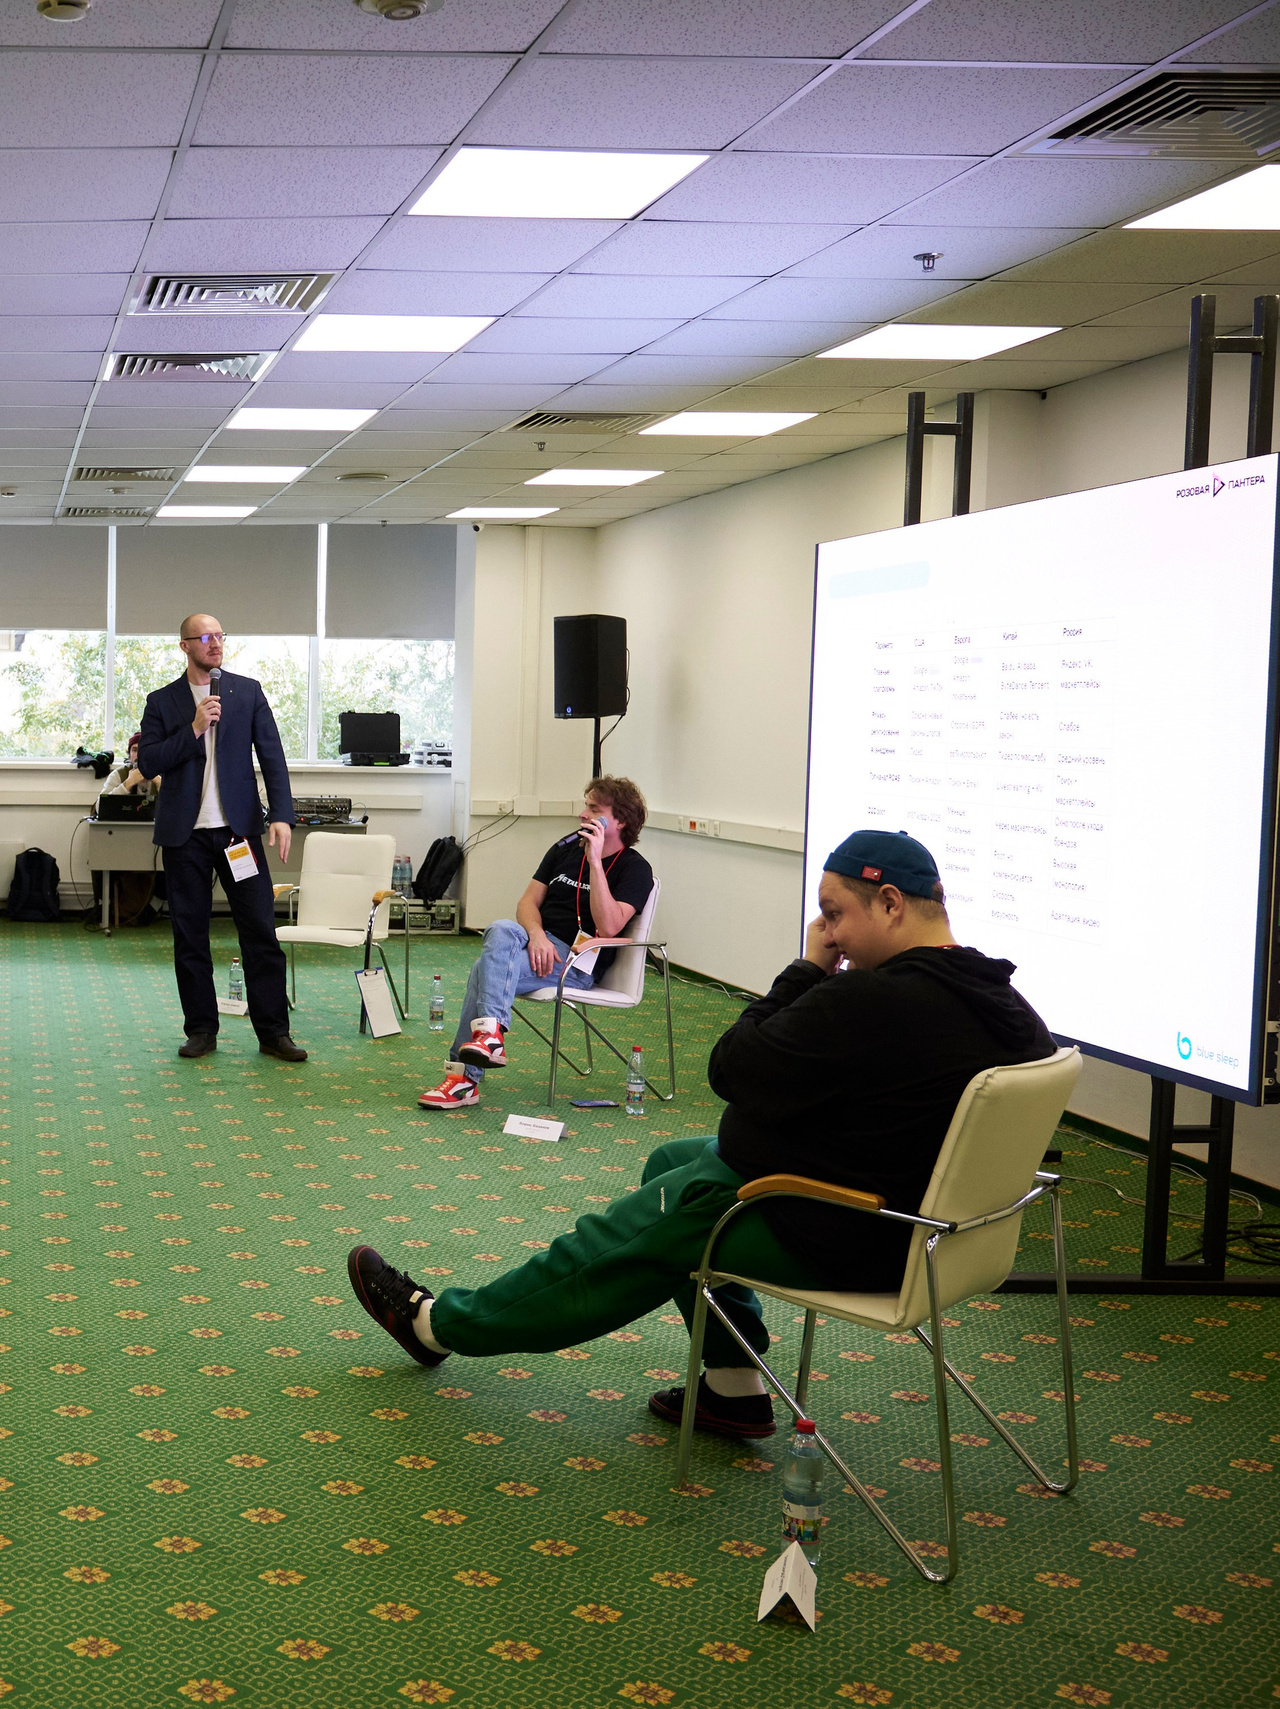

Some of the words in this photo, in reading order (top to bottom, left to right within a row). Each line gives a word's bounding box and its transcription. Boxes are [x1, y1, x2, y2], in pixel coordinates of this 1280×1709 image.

[1176, 484, 1210, 498] РОЗОВАЯ
[1228, 475, 1265, 489] ПАНТЕРА
[1062, 627, 1083, 637] Россия
[1058, 721, 1080, 731] Слабое
[1197, 1045, 1214, 1060] blue
[1216, 1050, 1239, 1070] sleep
